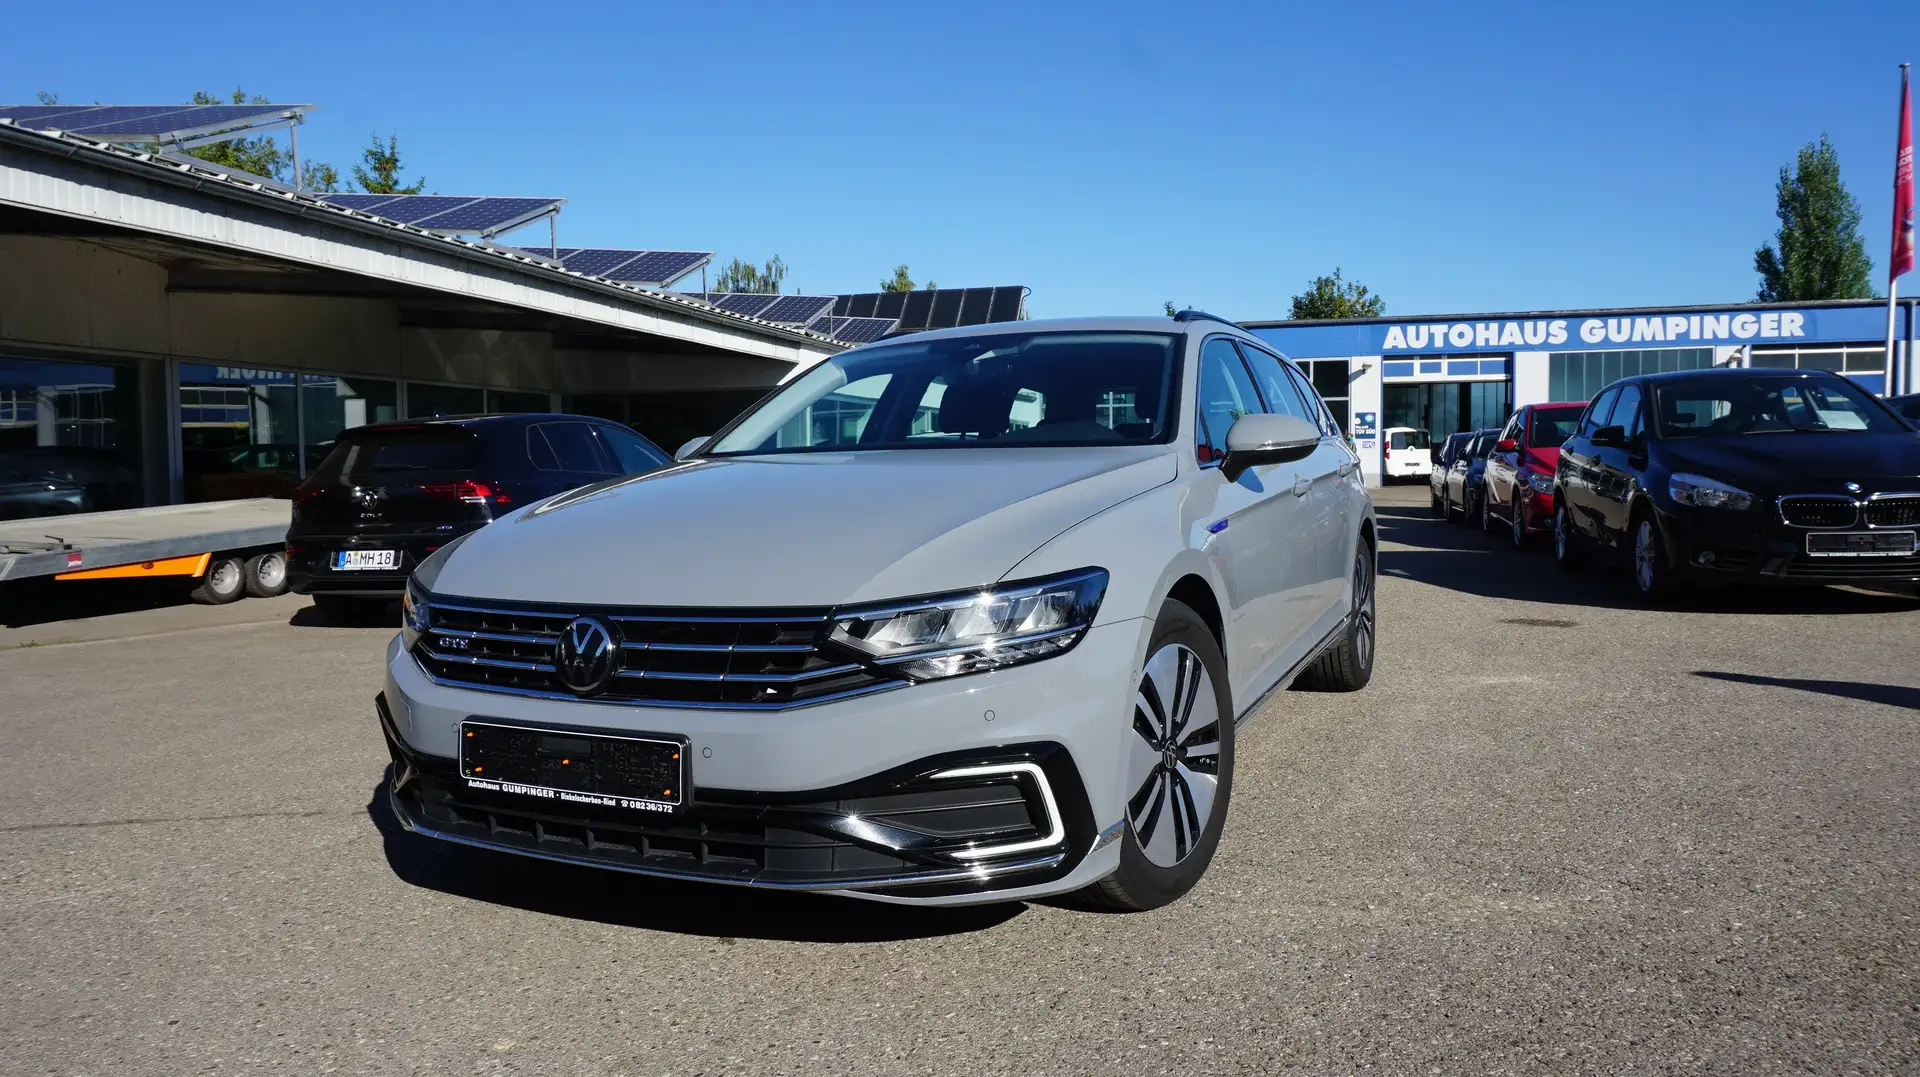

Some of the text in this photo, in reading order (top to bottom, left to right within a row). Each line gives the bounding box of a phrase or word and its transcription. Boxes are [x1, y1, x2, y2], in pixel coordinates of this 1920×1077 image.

[1383, 311, 1806, 349] AUTOHAUS GUMPINGER
[346, 552, 392, 565] A MH 18
[439, 637, 468, 649] GTE
[467, 779, 500, 791] Autohaus
[502, 783, 555, 799] GUMPINGER
[629, 800, 673, 813] 08236/372
